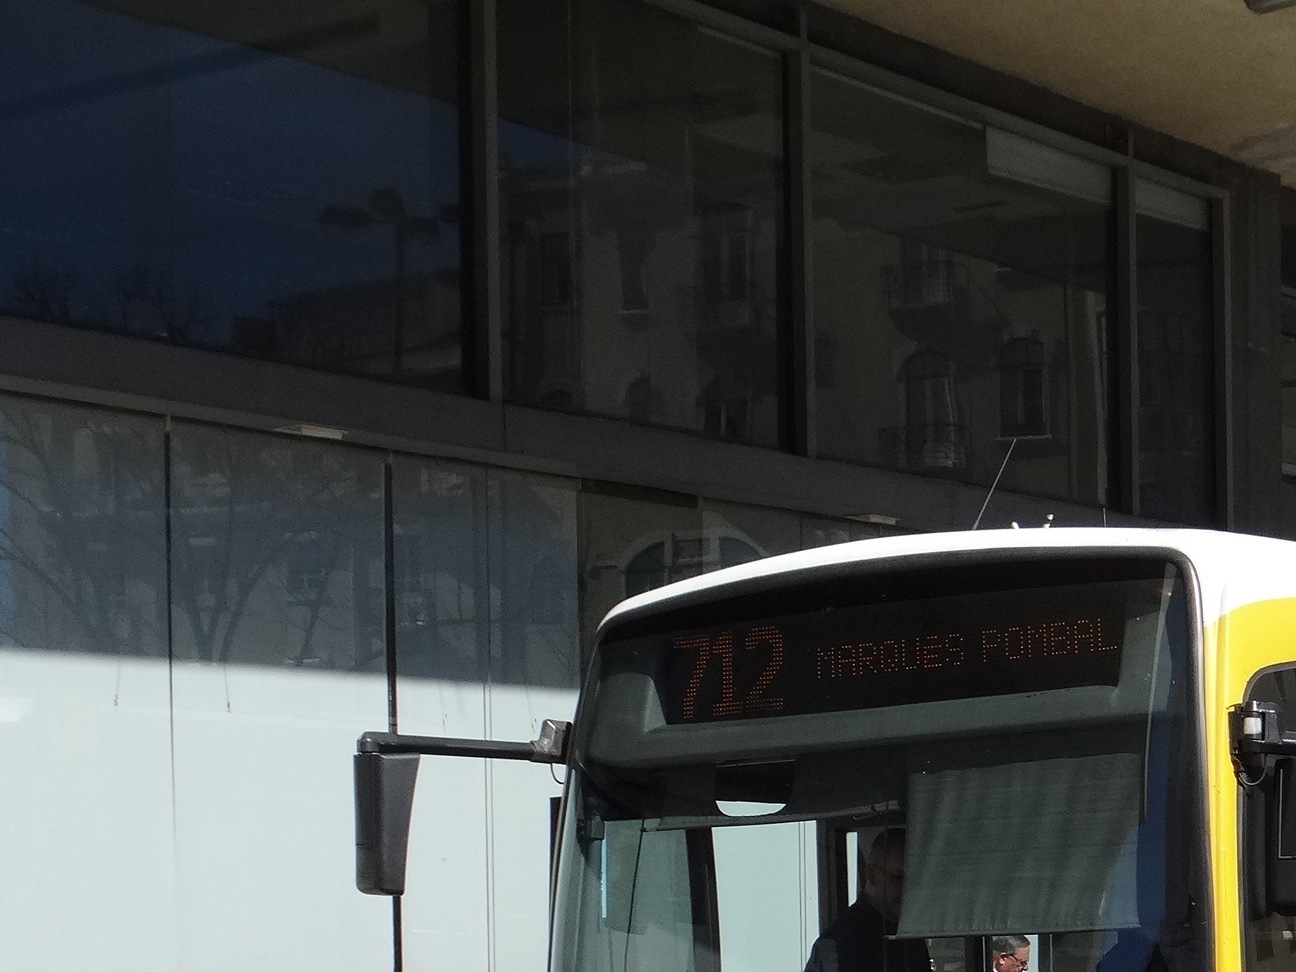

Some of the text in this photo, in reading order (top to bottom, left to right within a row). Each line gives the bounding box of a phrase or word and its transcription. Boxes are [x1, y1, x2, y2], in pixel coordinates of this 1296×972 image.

[673, 626, 784, 719] 712
[816, 618, 1118, 679] MARQUES POMBAL
